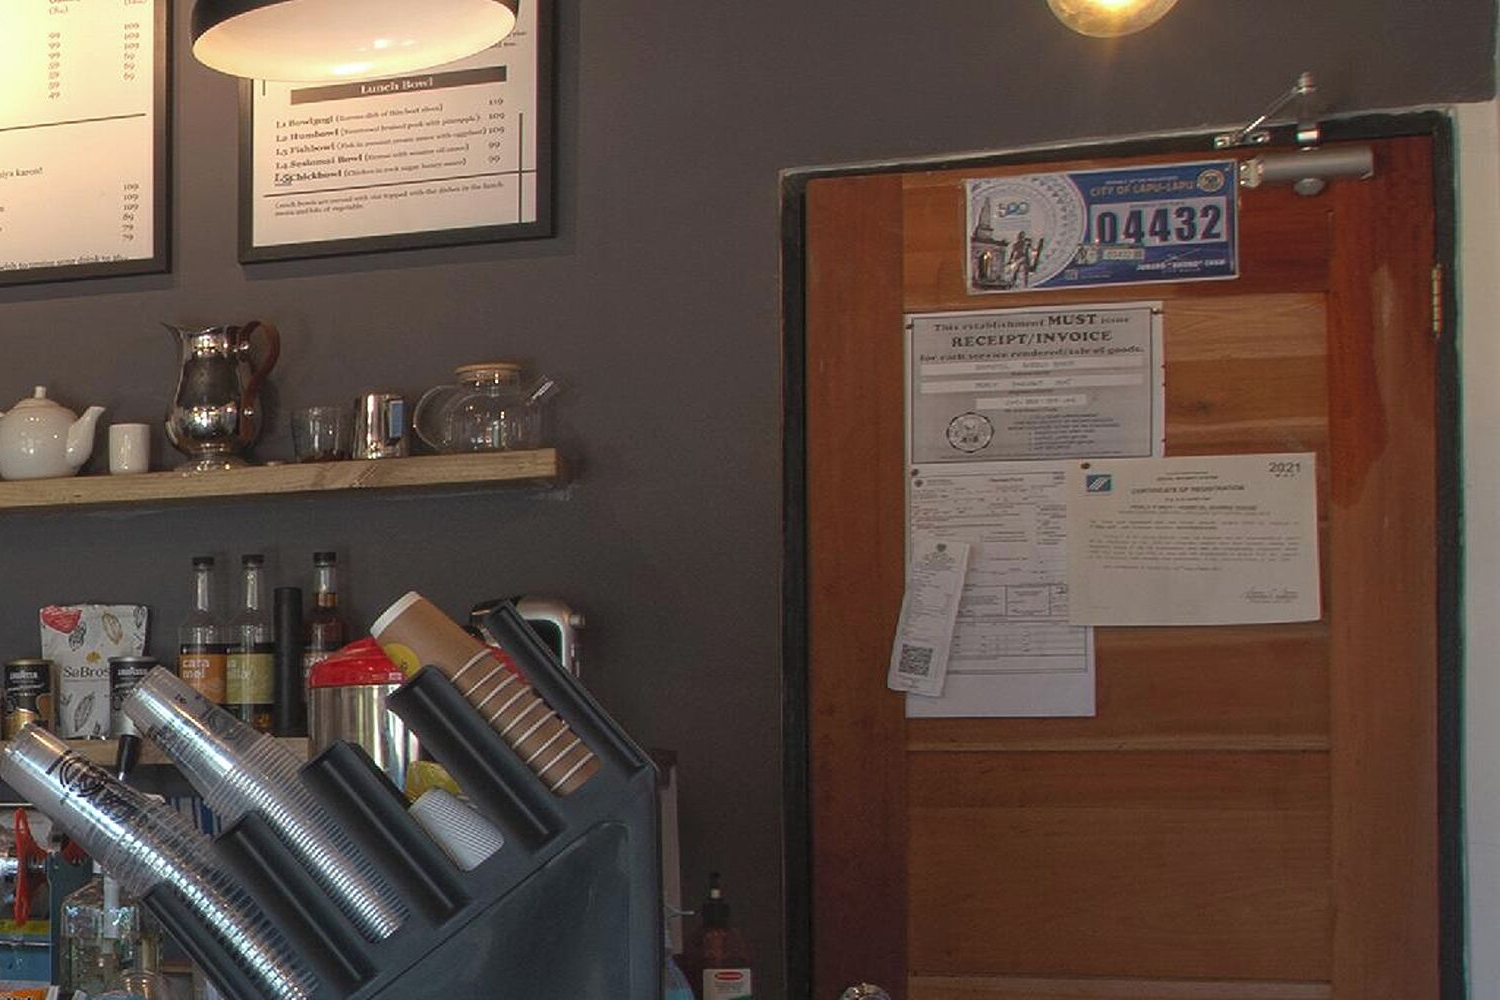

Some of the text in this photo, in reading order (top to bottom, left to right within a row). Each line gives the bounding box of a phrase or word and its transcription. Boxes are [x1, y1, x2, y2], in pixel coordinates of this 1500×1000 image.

[360, 76, 434, 99] Lunch Bowl
[1097, 204, 1222, 246] 04432
[934, 321, 960, 332] This
[962, 318, 1046, 334] establishment
[1048, 313, 1099, 327] MUST
[950, 330, 1114, 349] RECEIPT/INVOICE
[1269, 462, 1302, 475] 2021
[182, 659, 210, 669] cara
[182, 668, 206, 679] mel
